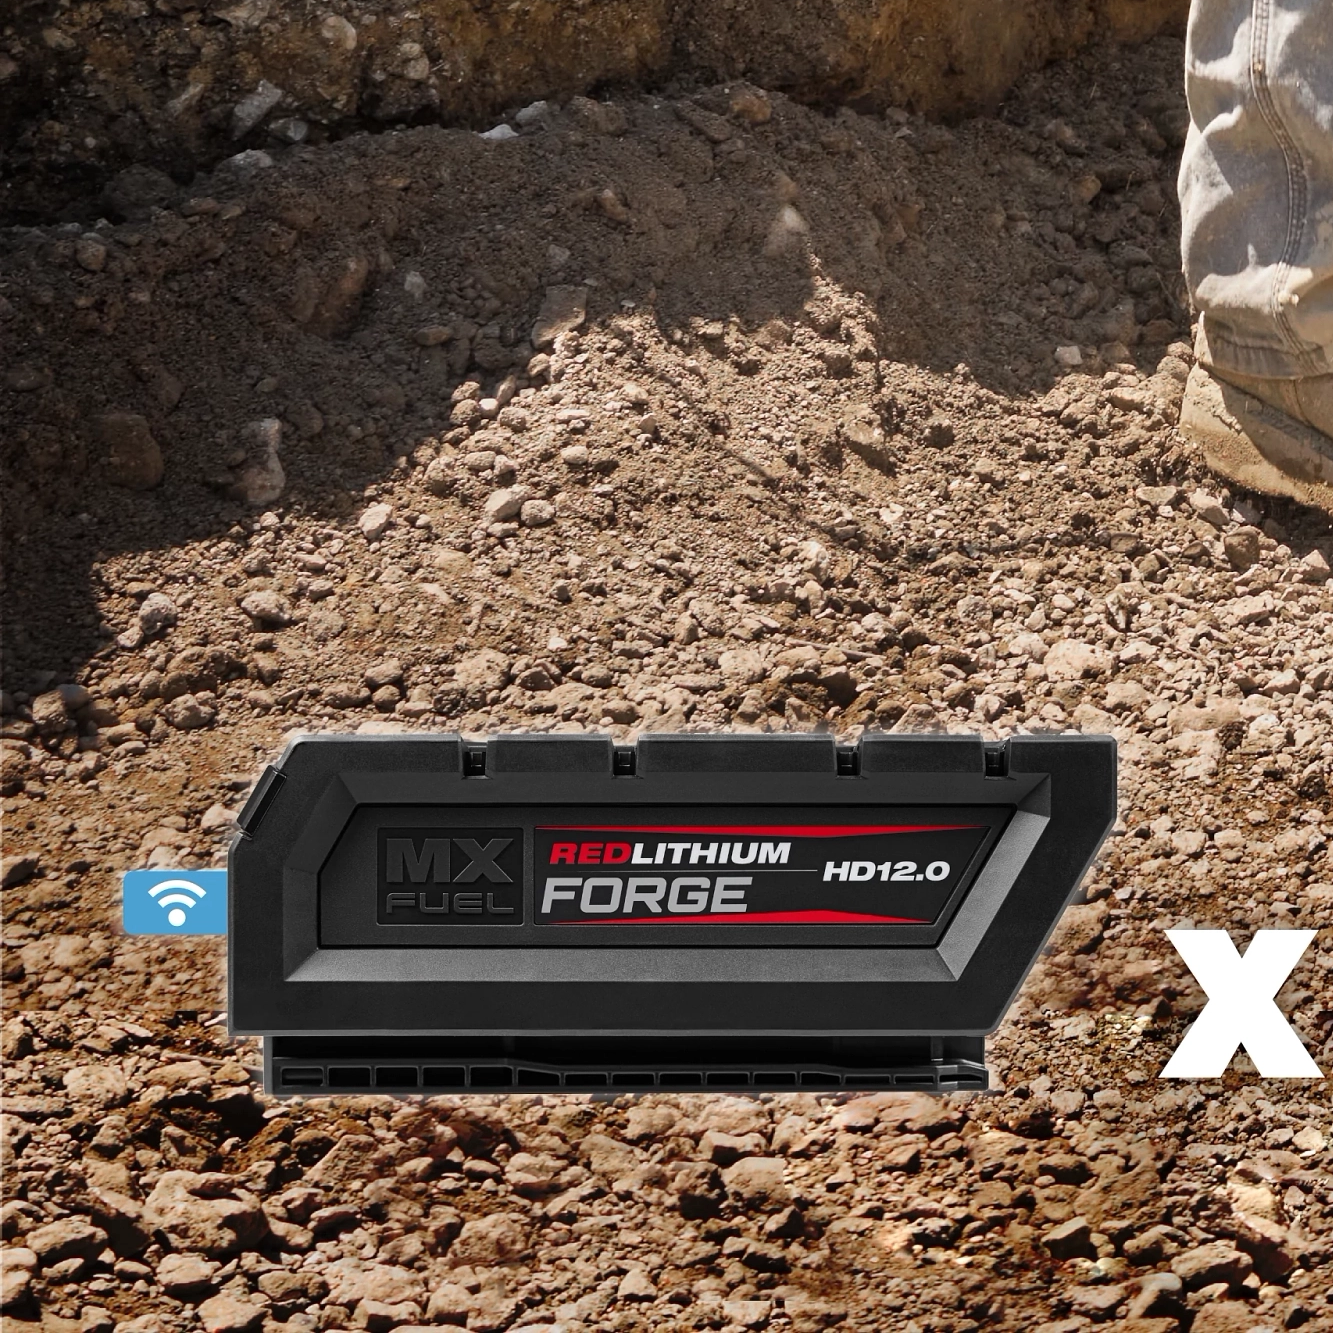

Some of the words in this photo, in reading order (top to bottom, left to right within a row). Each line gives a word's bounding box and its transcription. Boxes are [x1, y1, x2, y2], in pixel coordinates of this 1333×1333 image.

[386, 837, 513, 884] MX
[549, 842, 791, 865] REDLITHIUM
[822, 860, 950, 882] HD12.0
[386, 892, 514, 914] FUEL
[541, 876, 753, 913] FORGE
